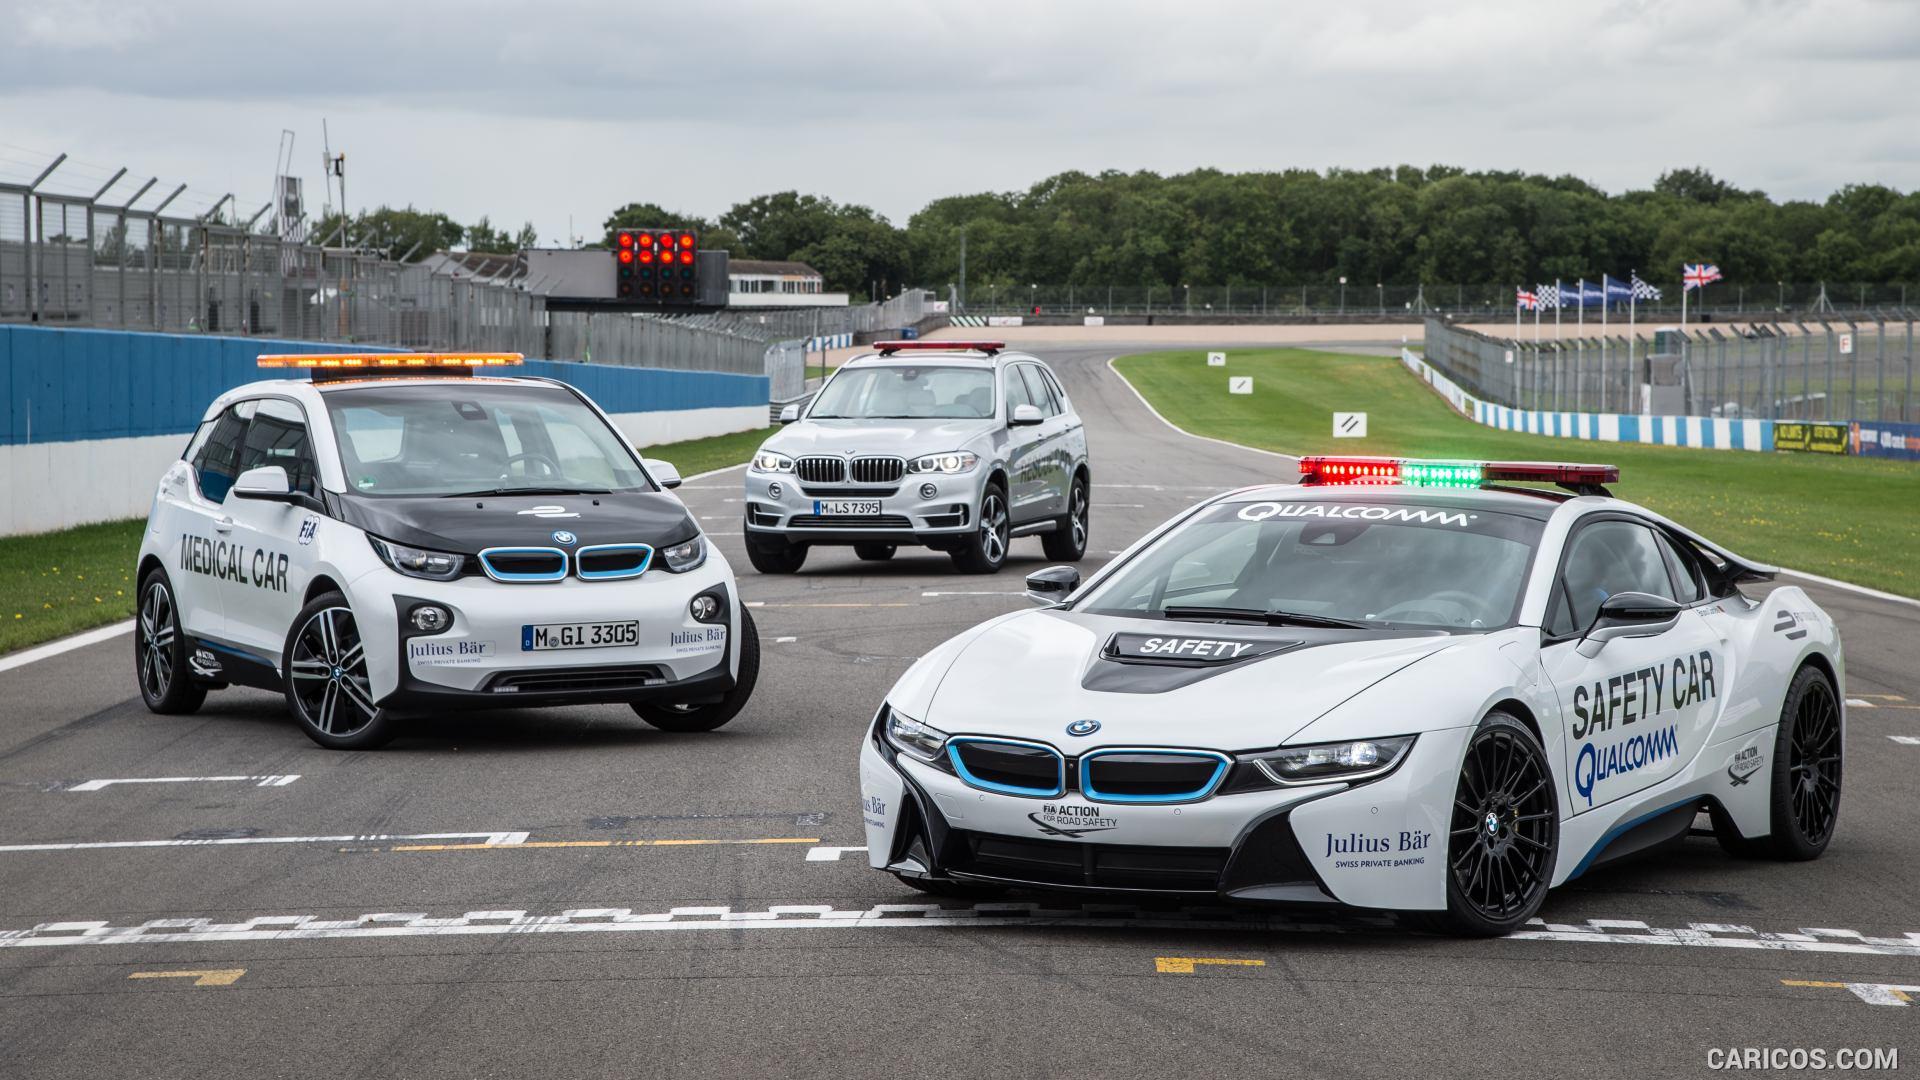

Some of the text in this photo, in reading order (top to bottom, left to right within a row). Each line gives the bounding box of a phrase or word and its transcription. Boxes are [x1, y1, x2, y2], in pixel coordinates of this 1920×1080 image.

[821, 503, 878, 514] M LS 7395
[1238, 502, 1467, 527] QUALCOMM
[180, 533, 289, 593] MEDICAL CAR
[535, 624, 637, 648] M GI 3305
[671, 628, 726, 647] Julius Bär
[410, 641, 486, 659] Julius Bär
[1139, 638, 1252, 658] SAFETY
[1573, 650, 1716, 740] SAFETY CAR
[1575, 725, 1679, 806] QUALCOMM
[871, 796, 886, 816] Bär
[1059, 805, 1100, 817] ACTION
[1057, 816, 1081, 826] ROAD
[1083, 818, 1118, 827] SAFETY
[1325, 830, 1431, 858] Julius Bär
[1335, 857, 1425, 868] SWISS PRIVATE BANKING
